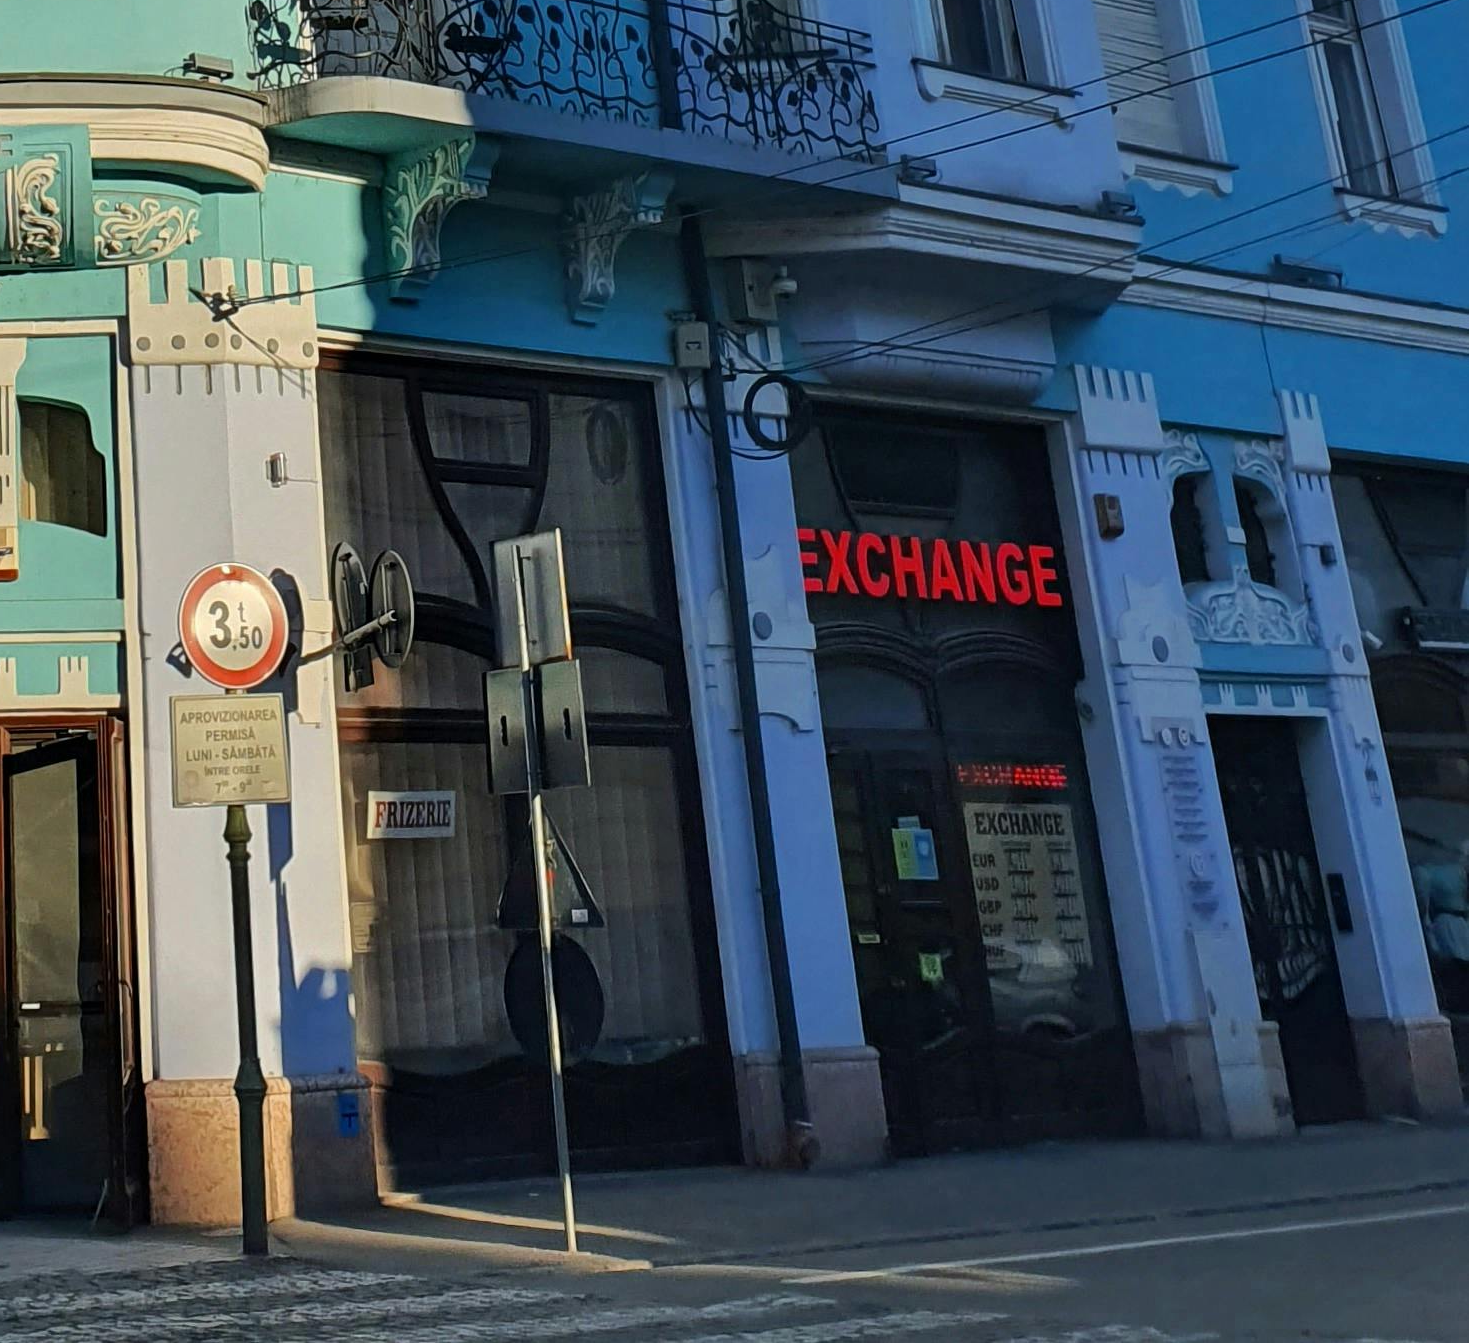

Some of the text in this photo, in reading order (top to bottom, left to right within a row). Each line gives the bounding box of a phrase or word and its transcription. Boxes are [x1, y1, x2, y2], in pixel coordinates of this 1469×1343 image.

[796, 528, 1063, 607] EXCHANGE
[179, 708, 278, 724] APROVIZIONAREA
[186, 749, 212, 762] LUNI
[232, 764, 261, 775] ORELE
[374, 800, 451, 828] FRIZERIE
[973, 812, 1065, 836] EXCHANGE
[972, 854, 996, 868] EUR
[975, 877, 999, 891] USD
[979, 900, 1002, 914] GBP
[982, 924, 1003, 937] CHF
